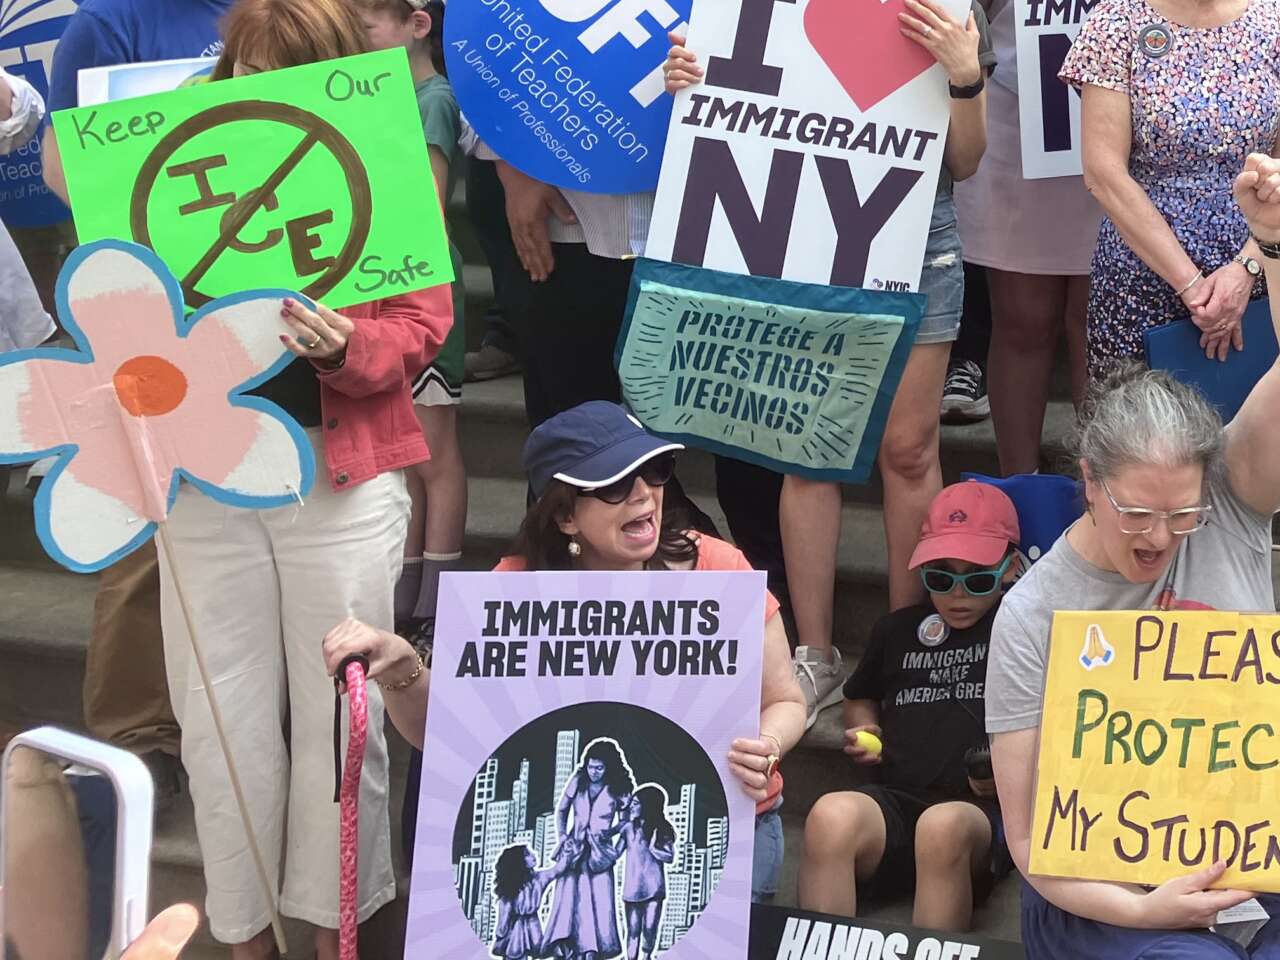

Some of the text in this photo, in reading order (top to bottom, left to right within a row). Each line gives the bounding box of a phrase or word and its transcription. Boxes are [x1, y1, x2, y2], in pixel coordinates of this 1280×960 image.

[72, 108, 166, 150] Keep
[325, 69, 392, 102] Our
[451, 39, 592, 185] A Union of Professionals
[485, 33, 599, 152] of Teachers
[541, 49, 648, 163] Federation
[681, 93, 938, 162] IMMIGRANT
[166, 154, 340, 277] ICE
[671, 136, 925, 290] NY
[354, 255, 434, 293] Safe
[676, 309, 846, 356] PROTEGE A
[669, 340, 835, 398] NUESTROS
[674, 376, 810, 435] VECINOS
[481, 600, 720, 638] IMMIGRANTS
[455, 639, 739, 678] ARE NEW YORK!
[902, 643, 987, 670] IMMIGRAN
[895, 683, 986, 706] AMERICA GRE
